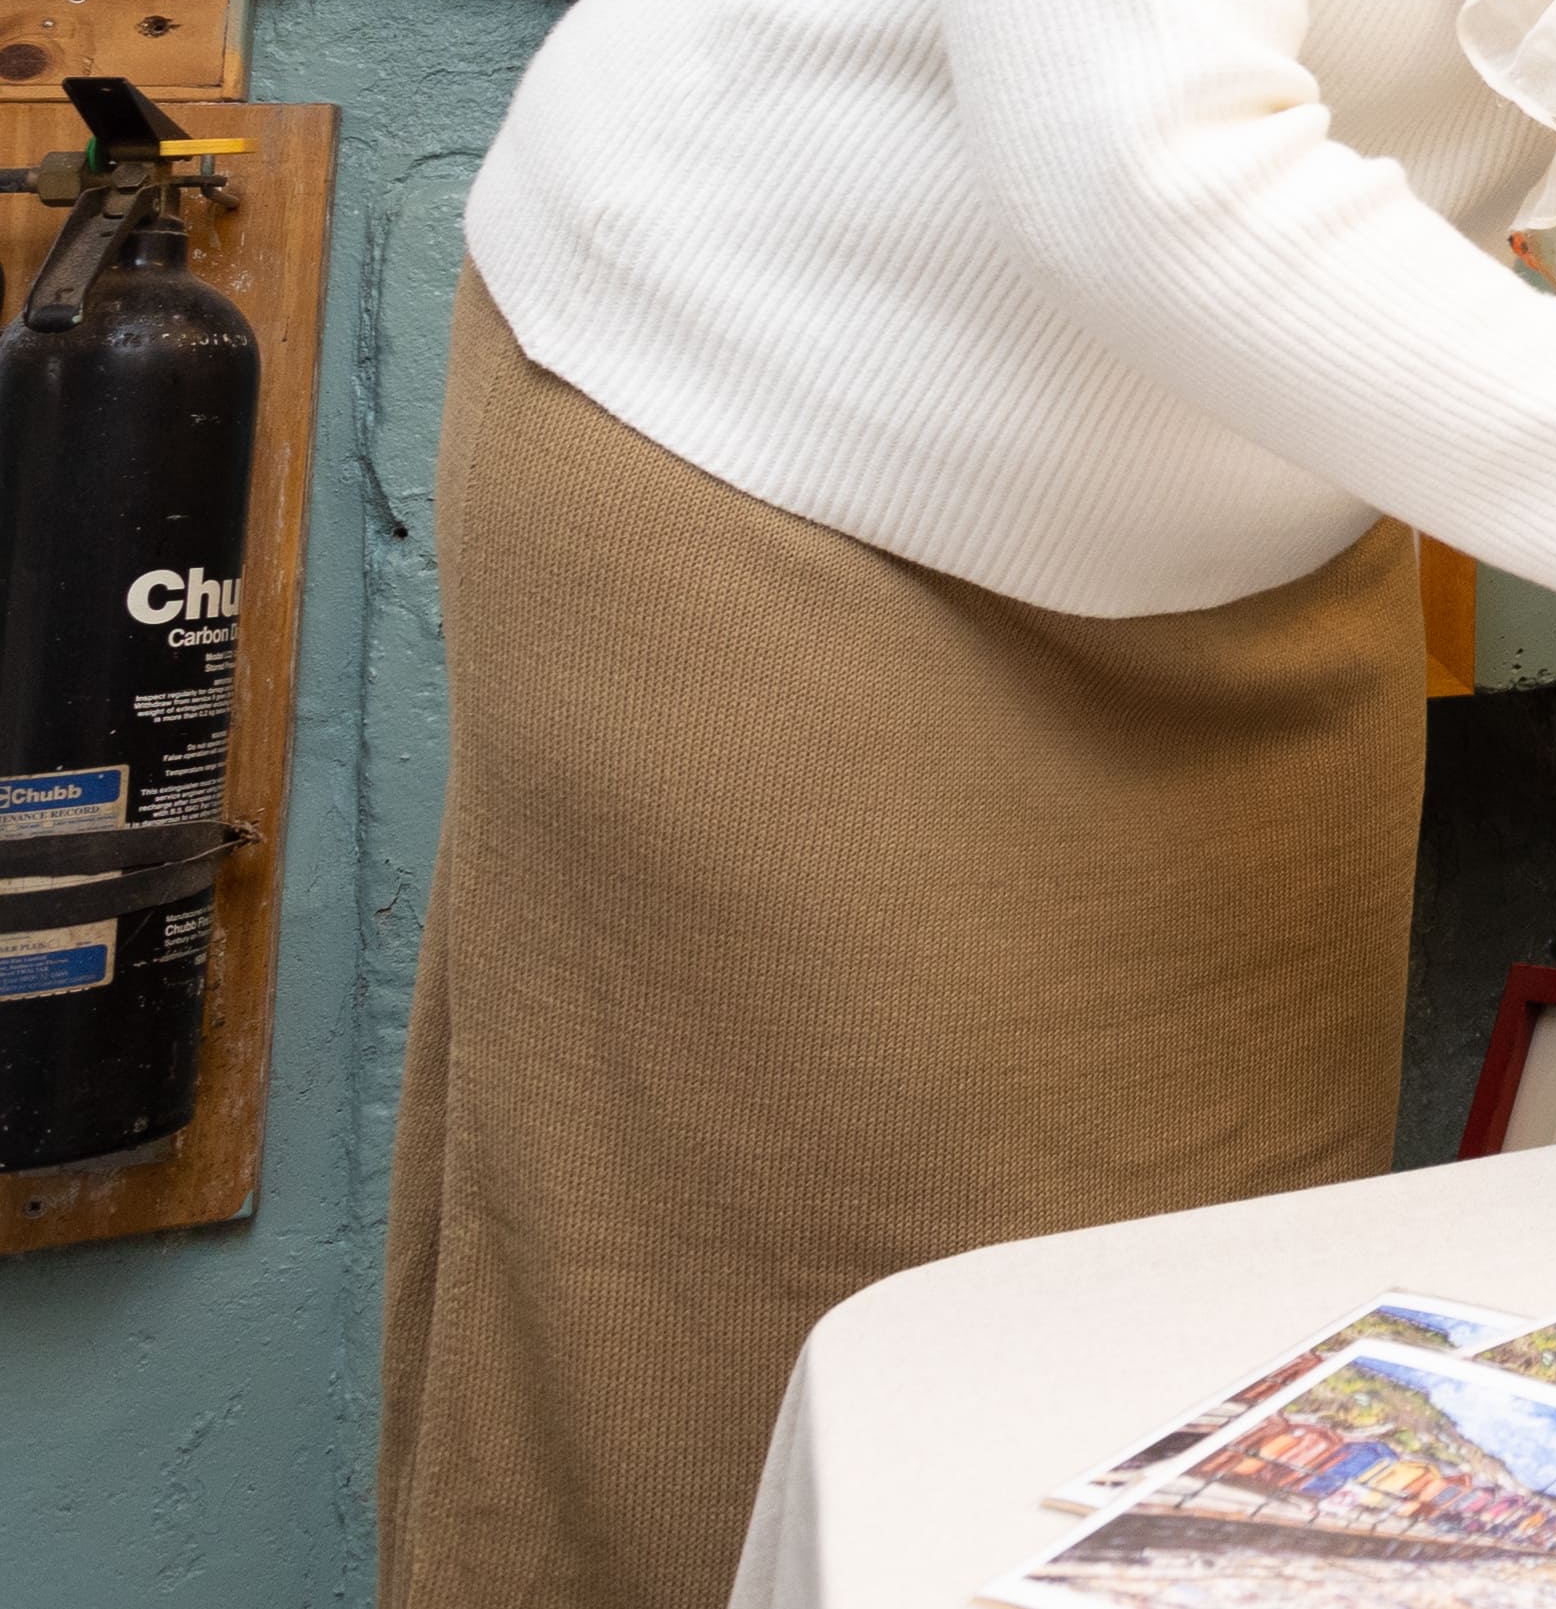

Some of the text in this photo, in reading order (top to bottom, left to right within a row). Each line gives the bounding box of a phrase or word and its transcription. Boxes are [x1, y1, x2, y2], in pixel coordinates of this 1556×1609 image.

[127, 566, 241, 625] Chu
[168, 626, 229, 648] Carbon
[11, 784, 83, 805] Chubb
[50, 805, 101, 819] RECORD
[164, 919, 197, 937] Chubb
